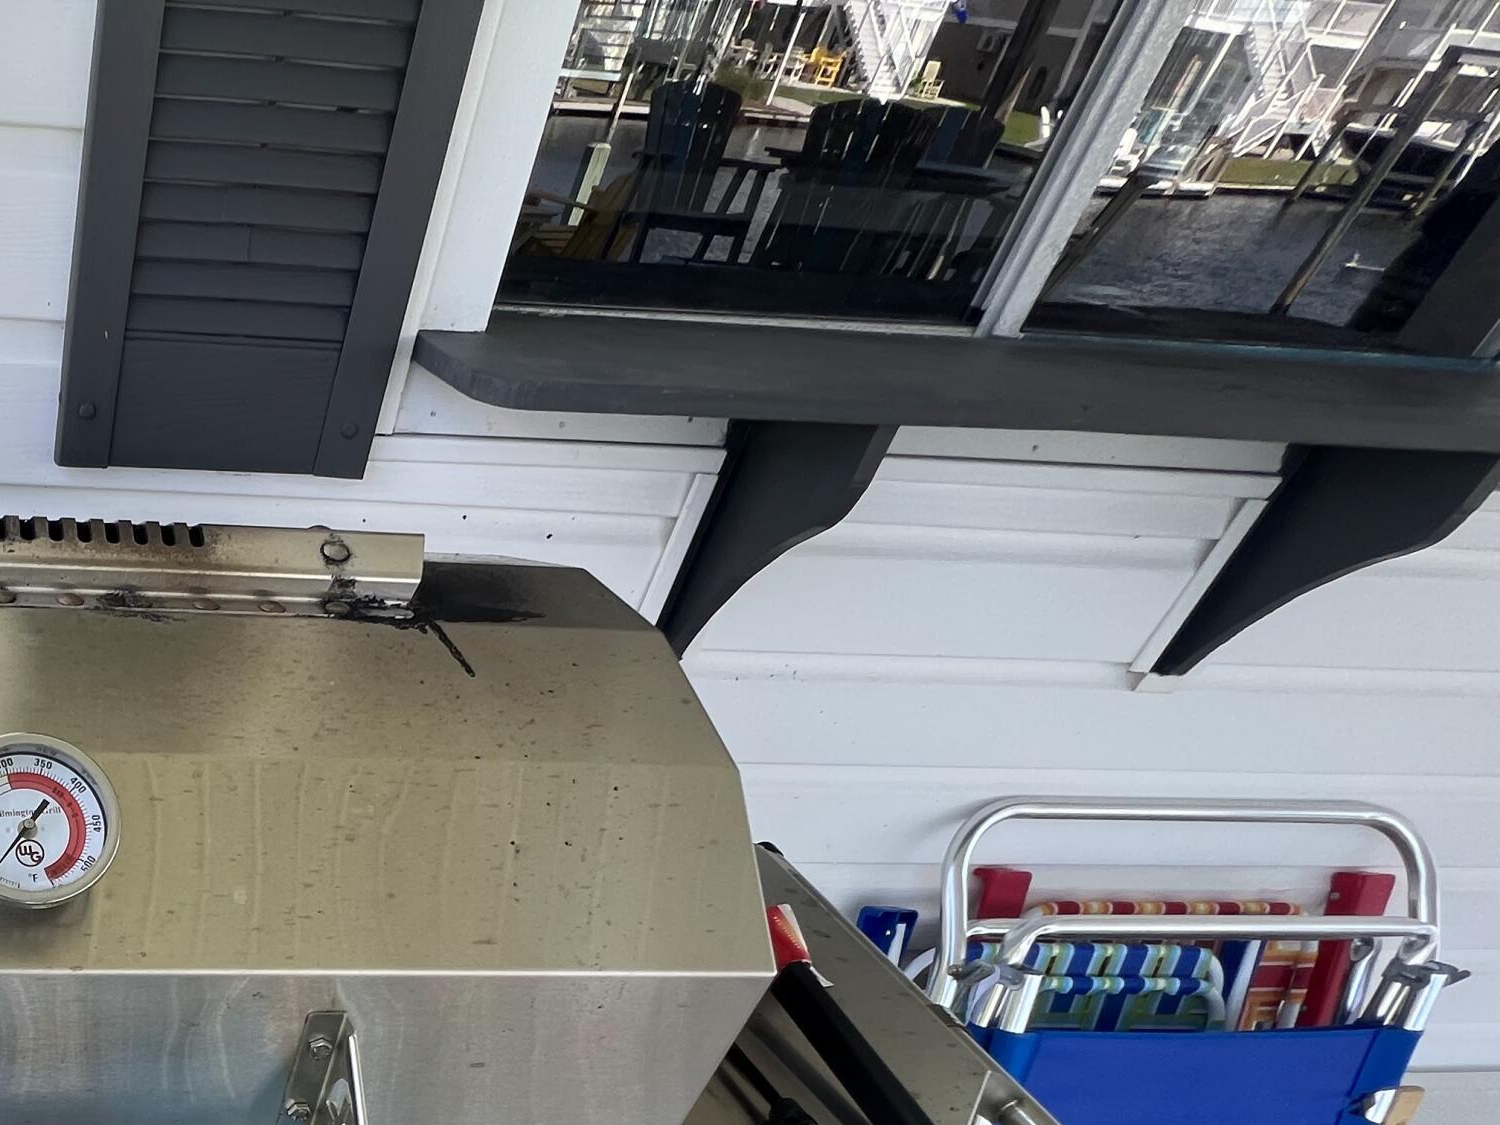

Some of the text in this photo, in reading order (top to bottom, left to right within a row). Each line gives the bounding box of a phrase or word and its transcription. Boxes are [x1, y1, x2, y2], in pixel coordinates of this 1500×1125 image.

[34, 758, 53, 770] 350
[70, 777, 87, 793] 400
[92, 814, 103, 833] 450
[80, 855, 97, 872] 500
